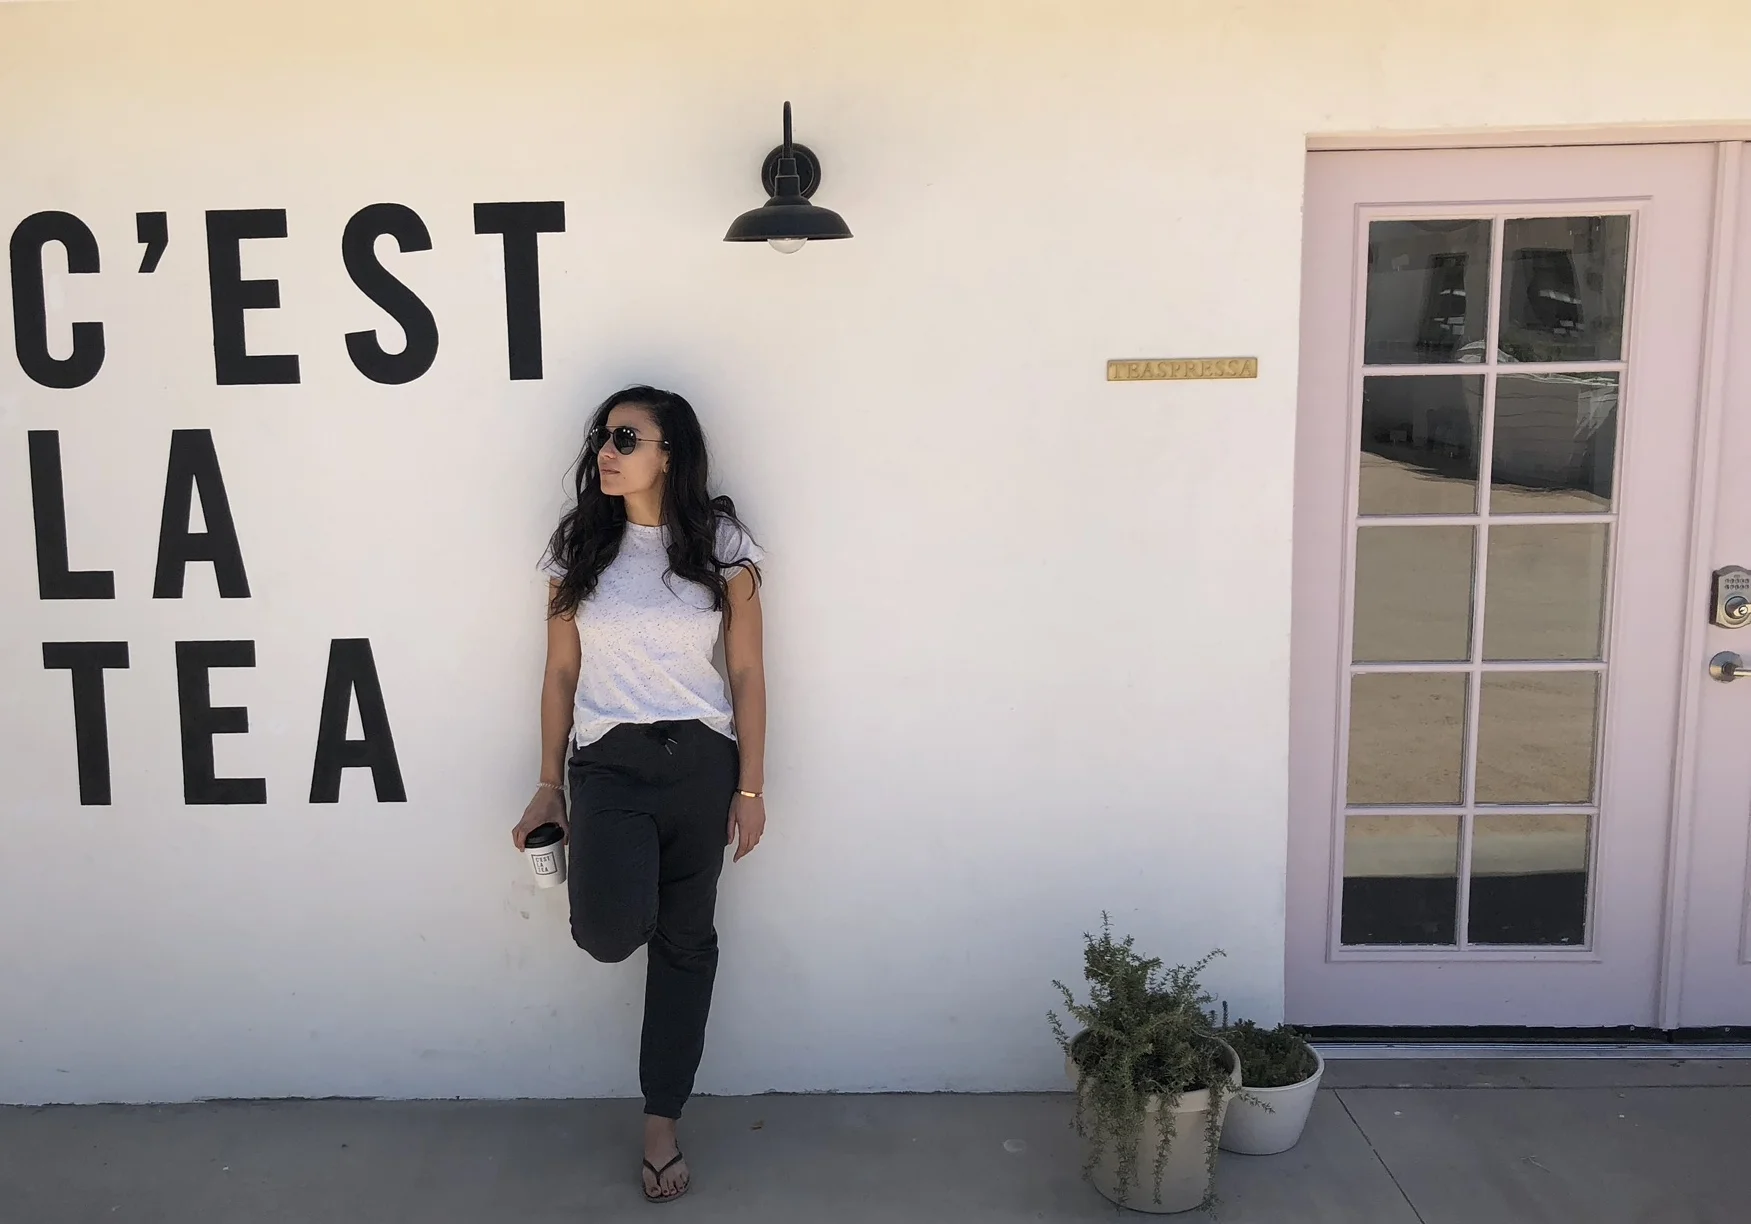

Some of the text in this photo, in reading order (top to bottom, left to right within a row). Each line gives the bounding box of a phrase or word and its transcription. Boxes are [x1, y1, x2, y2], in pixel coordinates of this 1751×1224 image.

[10, 201, 566, 389] C'EST
[1109, 359, 1252, 379] TEASPRESSA
[28, 429, 252, 601] LA
[42, 638, 408, 806] TEA
